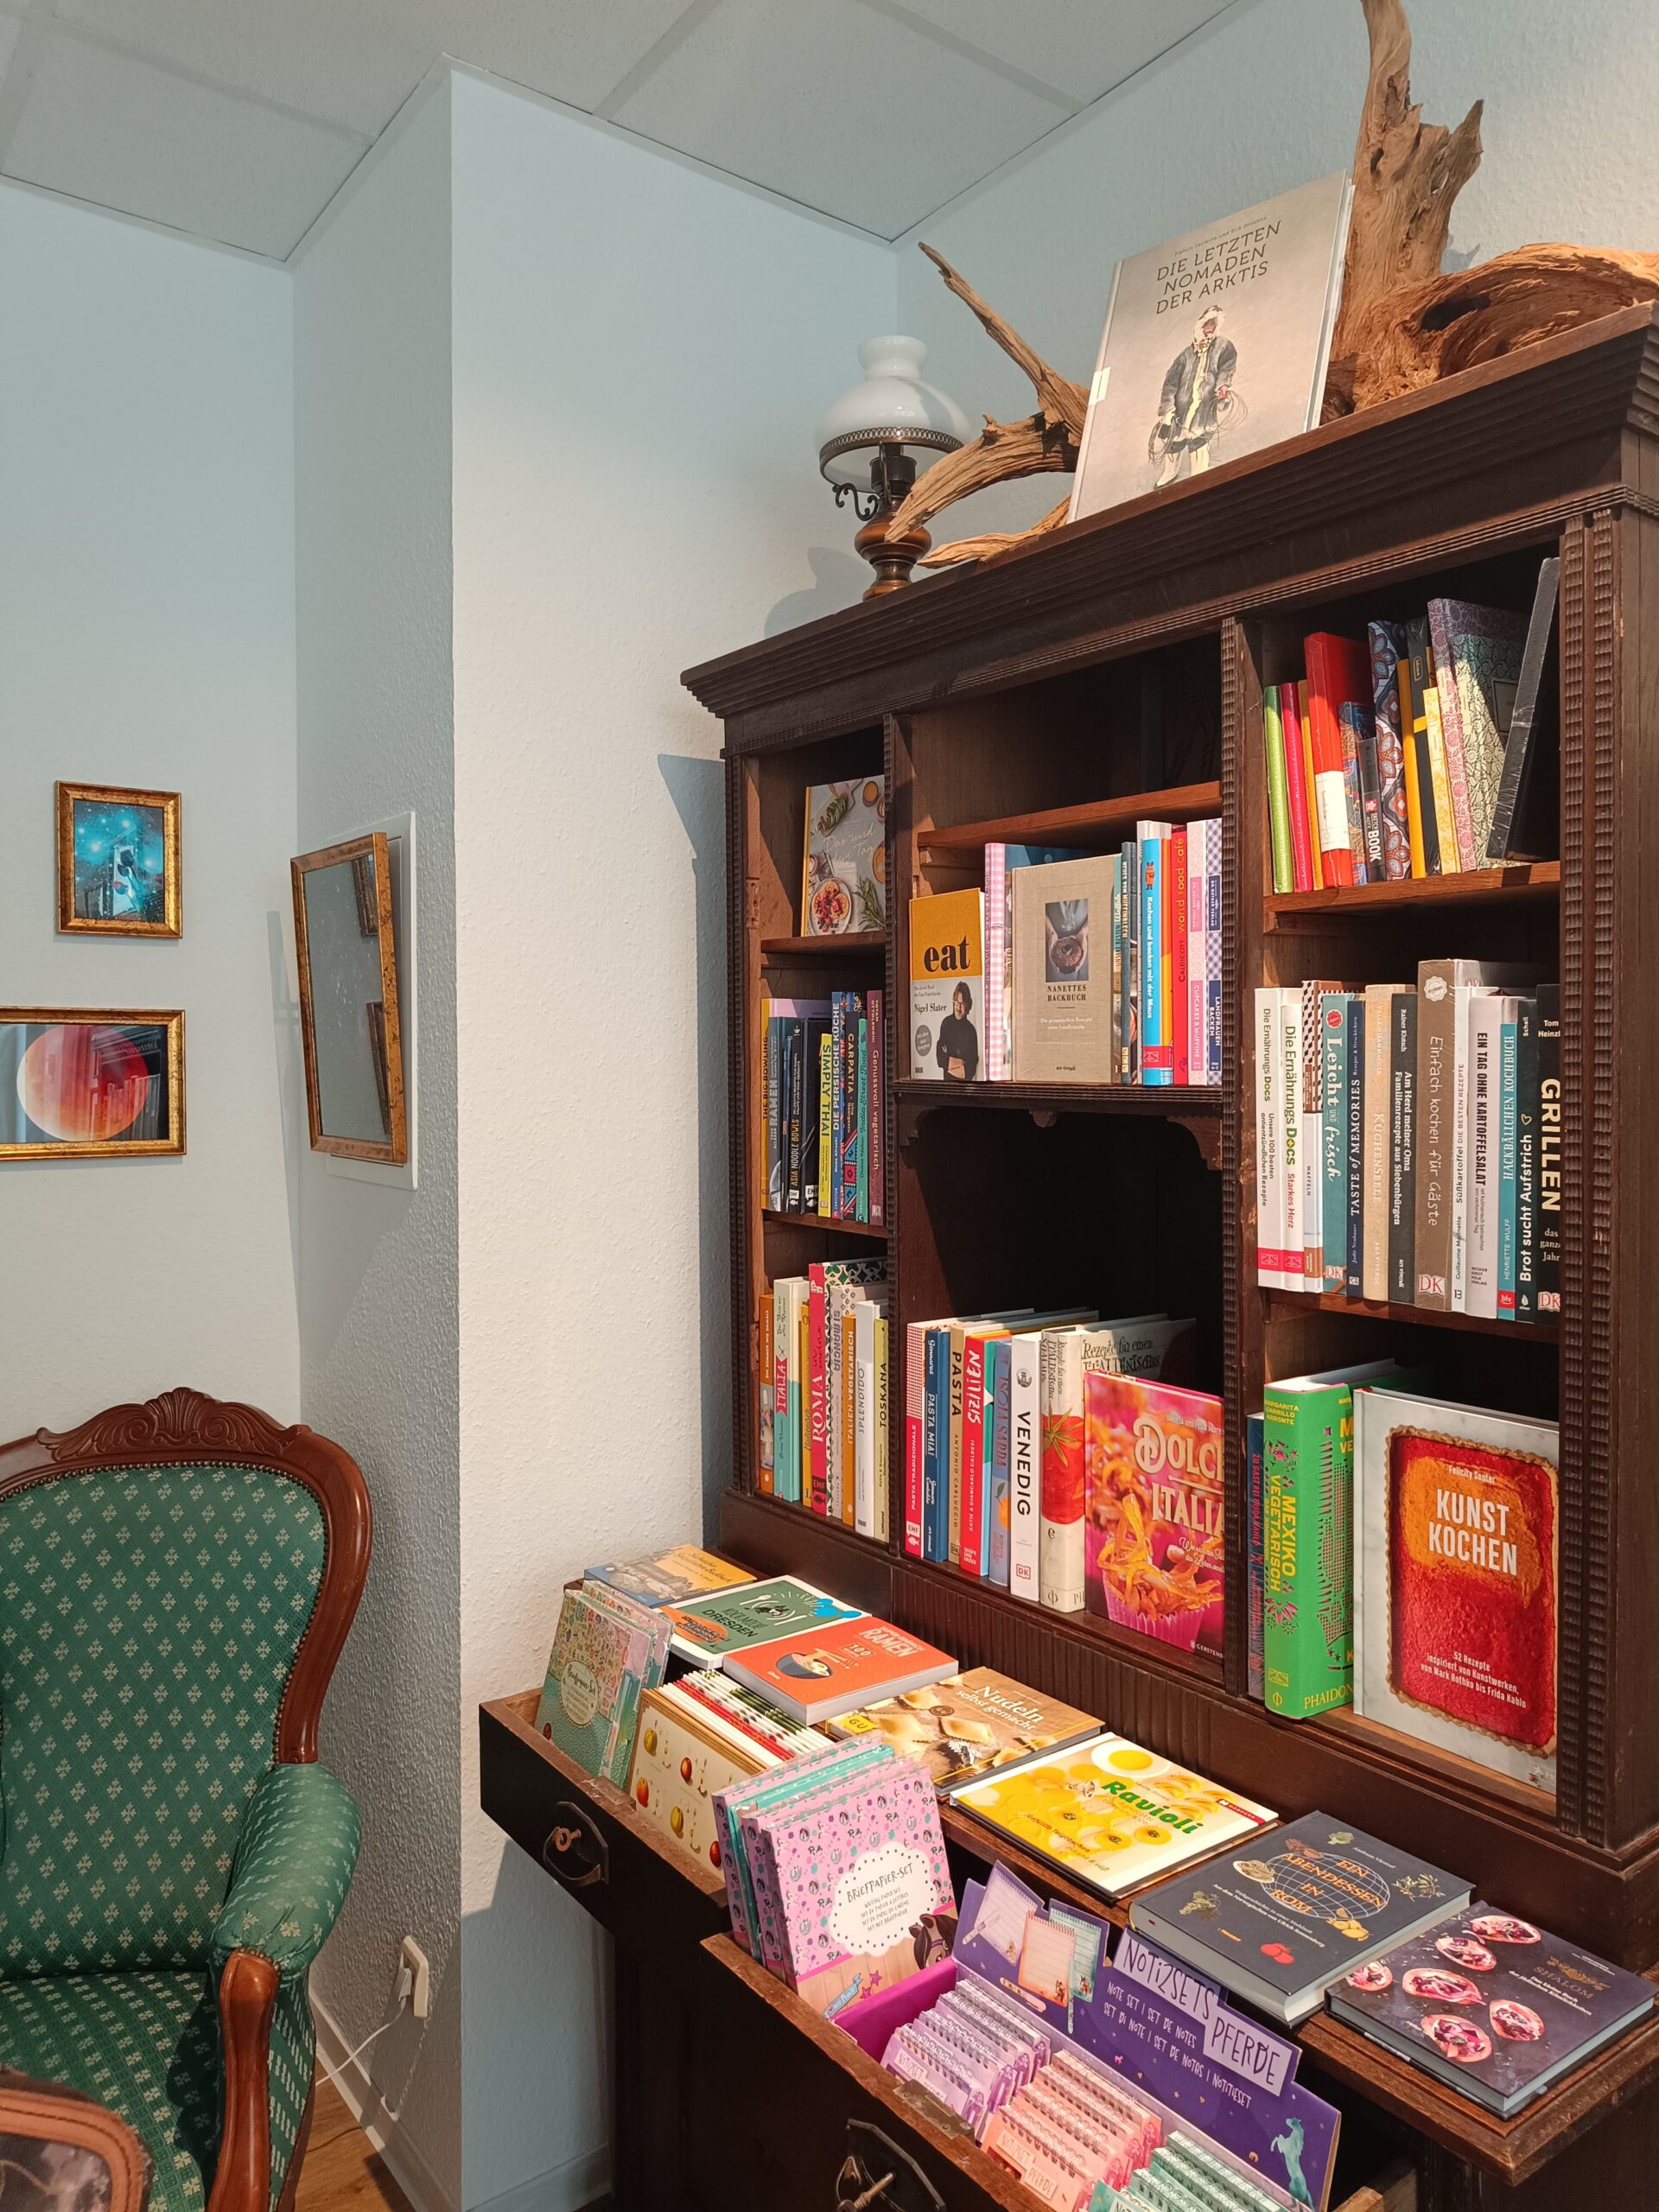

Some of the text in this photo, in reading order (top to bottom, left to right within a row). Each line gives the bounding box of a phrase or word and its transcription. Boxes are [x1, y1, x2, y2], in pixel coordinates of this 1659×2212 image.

[1157, 258, 1188, 282] DIE
[1194, 220, 1281, 267] LETZTEN
[1163, 243, 1267, 296] NOMADEN
[1156, 261, 1268, 315] DER ARKTIS
[1175, 837, 1184, 863] café
[1367, 830, 1382, 863] BOOK
[924, 935, 970, 973] eat
[913, 1002, 947, 1014] Nigel Slater
[1046, 984, 1087, 993] NANETTES
[1047, 994, 1086, 1002] BACKBUCH
[822, 1044, 831, 1097] SIMPLY
[1262, 1025, 1271, 1075] Ernährungs
[1326, 1037, 1343, 1107] Leicht
[769, 1079, 778, 1127] RAMEN
[820, 1101, 830, 1136] THAI
[1394, 1071, 1403, 1145] Familienrezepte
[1403, 1071, 1413, 1172] Am Herd meiner Oma
[1475, 1033, 1488, 1186] EIN TAG OHNE KARTOFFELSALAT
[1503, 1036, 1515, 1180] HACKBÄLLCHEN KOCHBUCH
[791, 1119, 799, 1141] BOWLS
[1284, 1026, 1297, 1229] Die Ernährungs Starkes Herz
[1349, 1078, 1361, 1217] TASTE of MEMORIES
[1427, 1036, 1444, 1227] Einfach kochen für Gäste
[1541, 1078, 1561, 1211] GRILLEN
[791, 1143, 799, 1169] NOODLE
[1324, 1126, 1342, 1183] frisch
[1373, 1113, 1384, 1204] KÜCHENSEELE
[1392, 1164, 1402, 1226] Siebenbürgen
[1519, 1135, 1532, 1282] Brot sucht Aufstrich
[1540, 1239, 1561, 1249] ganz
[1544, 1228, 1559, 1237] das
[1326, 1265, 1342, 1279] DK
[1541, 1252, 1560, 1262] Jahr
[1420, 1275, 1443, 1294] DK
[1500, 1294, 1513, 1303] blv
[1541, 1293, 1560, 1307] DK
[777, 1365, 786, 1408] ITALIA
[951, 1351, 962, 1416] PASTA
[966, 1350, 982, 1425] SIZILIEN
[811, 1375, 826, 1442] ROMA
[1017, 1411, 1031, 1516] VENEDIG
[1448, 1465, 1473, 1480] Felicity
[1270, 1475, 1281, 1592] VEGETARISCH
[1437, 1488, 1510, 1536] KUNST
[1281, 1495, 1296, 1578] MEXIKO
[1428, 1521, 1517, 1577] KOCHEN
[702, 1609, 759, 1637] DRESDEN
[858, 1628, 919, 1657] RAMEN
[849, 1643, 873, 1656] 100
[1453, 1650, 1491, 1672] 52 Rezepte
[1303, 1683, 1354, 1711] PHAIDON
[1421, 1662, 1527, 1708] von Mark Rothko bis Frida Kahlo
[1459, 1665, 1520, 1694] von Kunstwerken,
[849, 1718, 869, 1730] GU
[956, 1689, 1037, 1731] selbst gemacht
[973, 1685, 1045, 1724] Nudeln
[1101, 1780, 1205, 1834] Ravioli
[1281, 1853, 1389, 1909] ABENDESSEN
[1300, 1882, 1325, 1897] IN
[1336, 1859, 1370, 1878] EIN
[1271, 1888, 1313, 1914] ROM
[1533, 1965, 1595, 1999] SHALOM
[1107, 1981, 1197, 2049] NOTE SET SET DE NOTES
[1103, 2002, 1205, 2079] SET NOTE SET DE NOTAS
[1211, 2016, 1281, 2087] PFERDE
[1027, 2166, 1058, 2196] PFERDE
